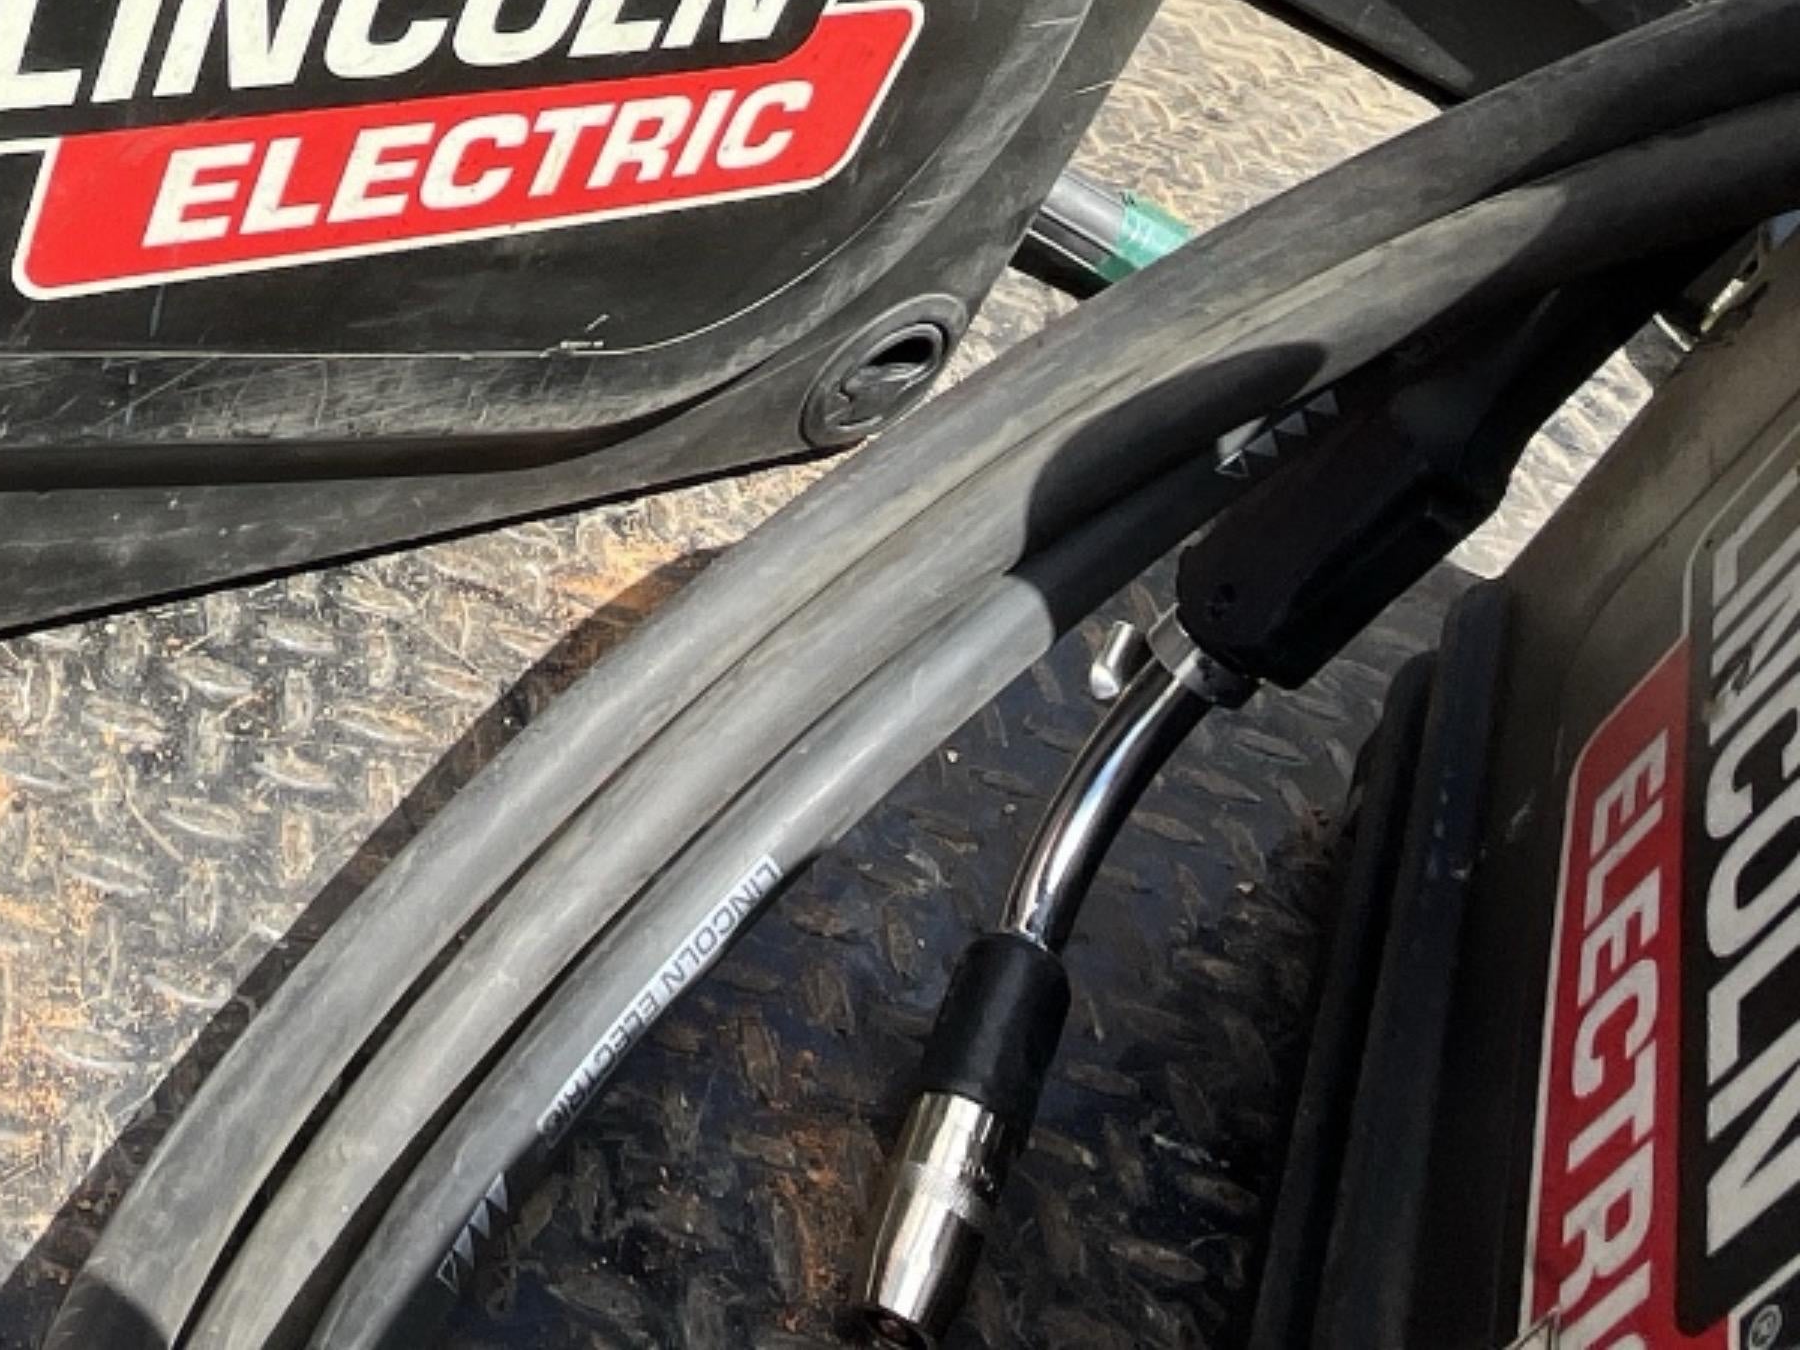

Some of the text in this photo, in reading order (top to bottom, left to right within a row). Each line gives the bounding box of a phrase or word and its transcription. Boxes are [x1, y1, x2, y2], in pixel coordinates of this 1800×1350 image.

[140, 78, 814, 248] ELECTRIC
[541, 860, 784, 1137] LINCOLN ELECTRIC
